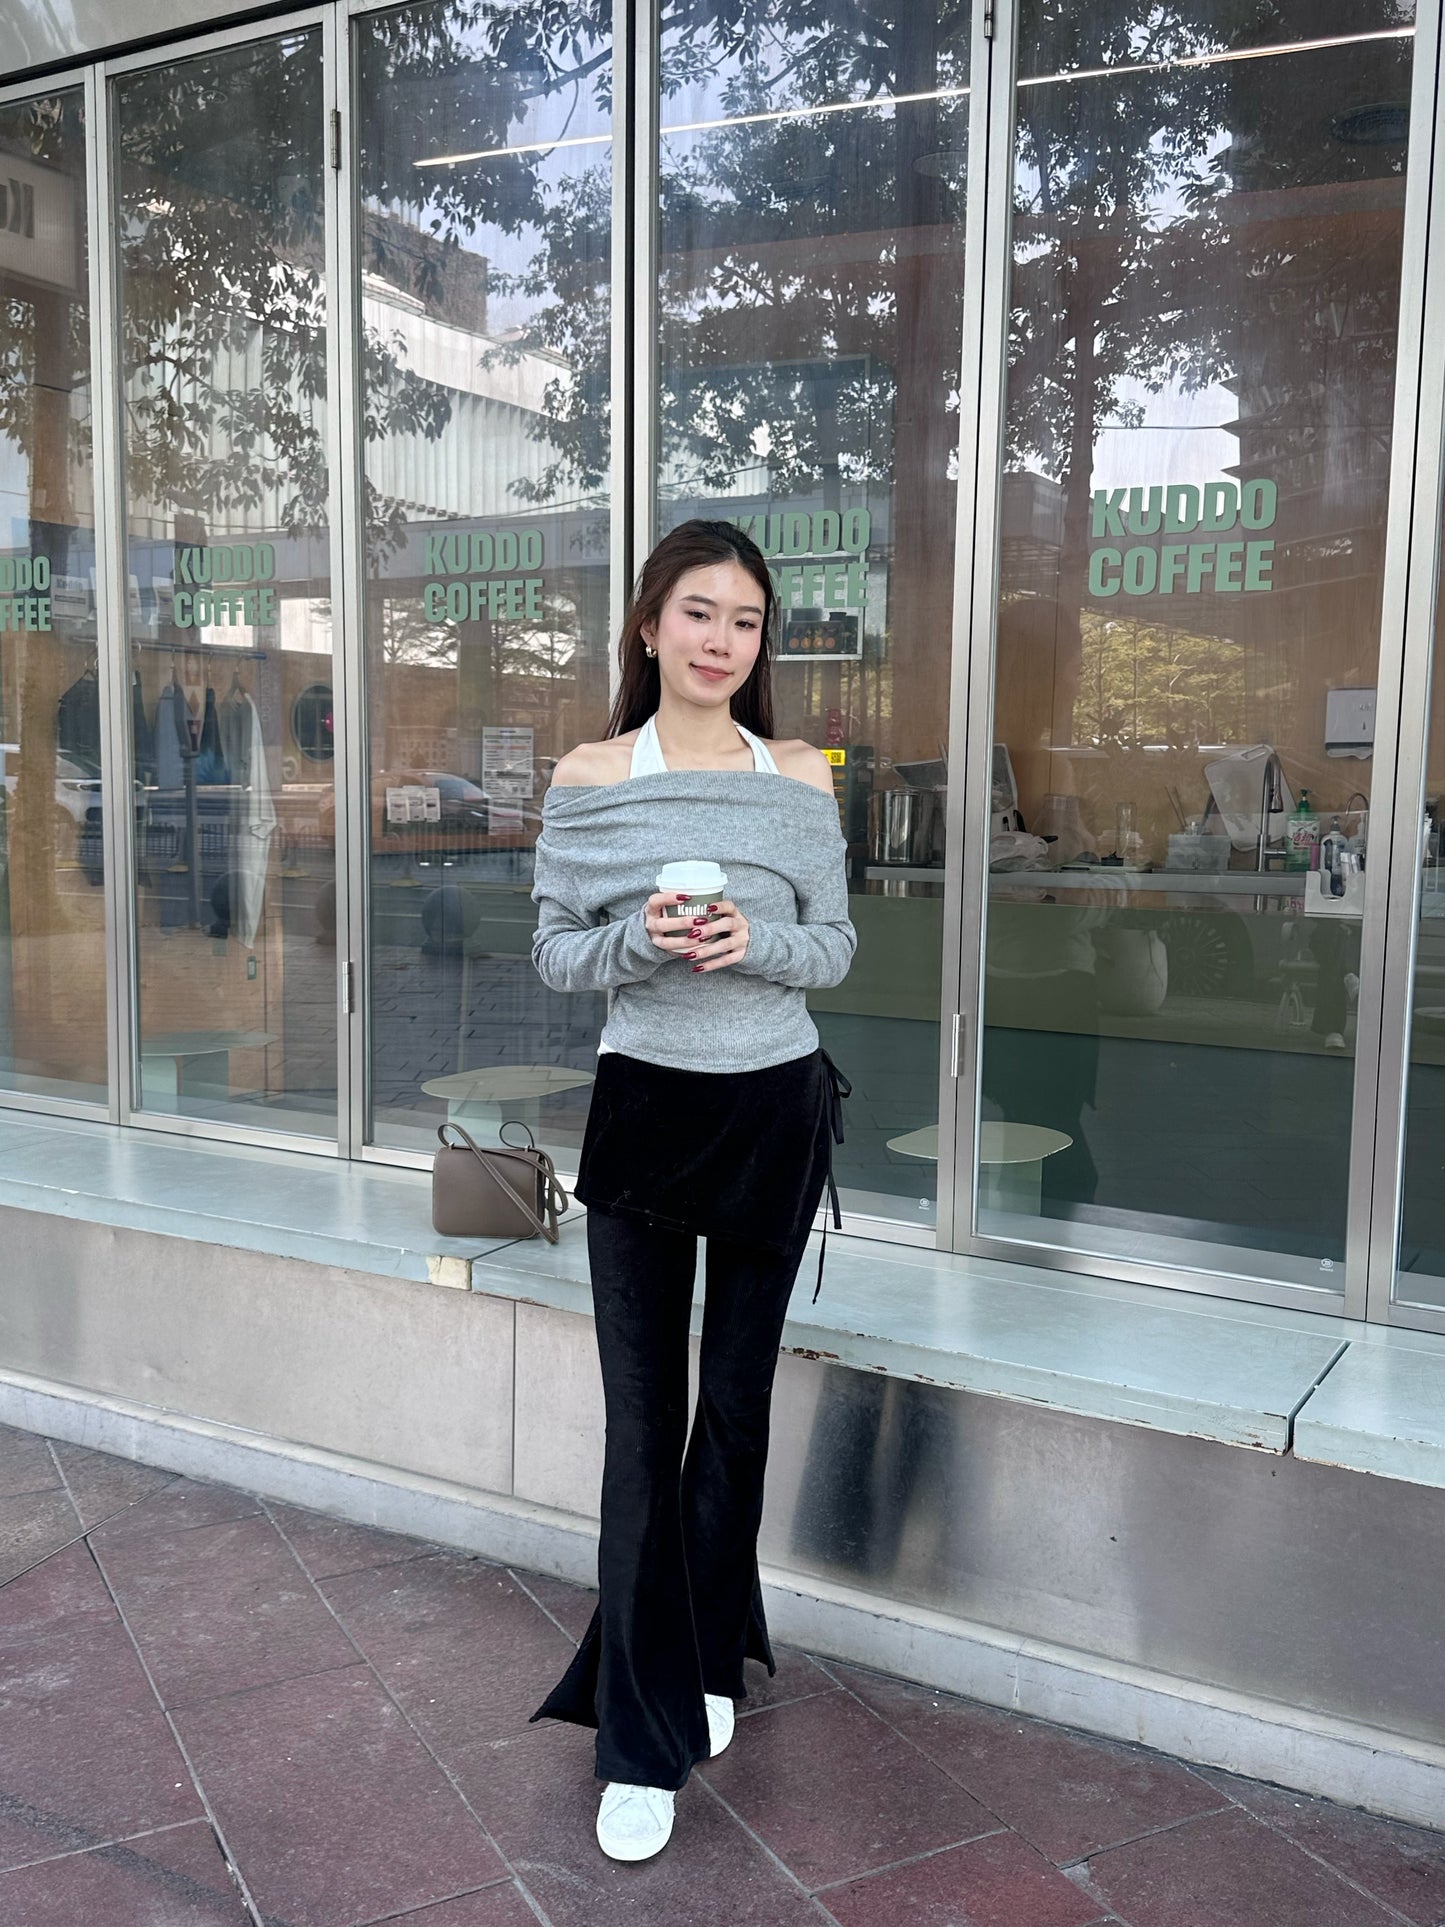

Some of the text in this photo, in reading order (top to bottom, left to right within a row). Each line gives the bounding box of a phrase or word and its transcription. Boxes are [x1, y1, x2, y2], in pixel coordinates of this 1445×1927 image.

[1092, 478, 1278, 538] KUDDO
[174, 543, 275, 585] KUDDO
[424, 529, 544, 575] KUDDO
[1088, 540, 1275, 597] COFFEE
[424, 579, 544, 623] COFFEE
[769, 562, 870, 609] FFEE
[174, 588, 275, 629] COFFEE
[677, 904, 712, 917] Kudd
